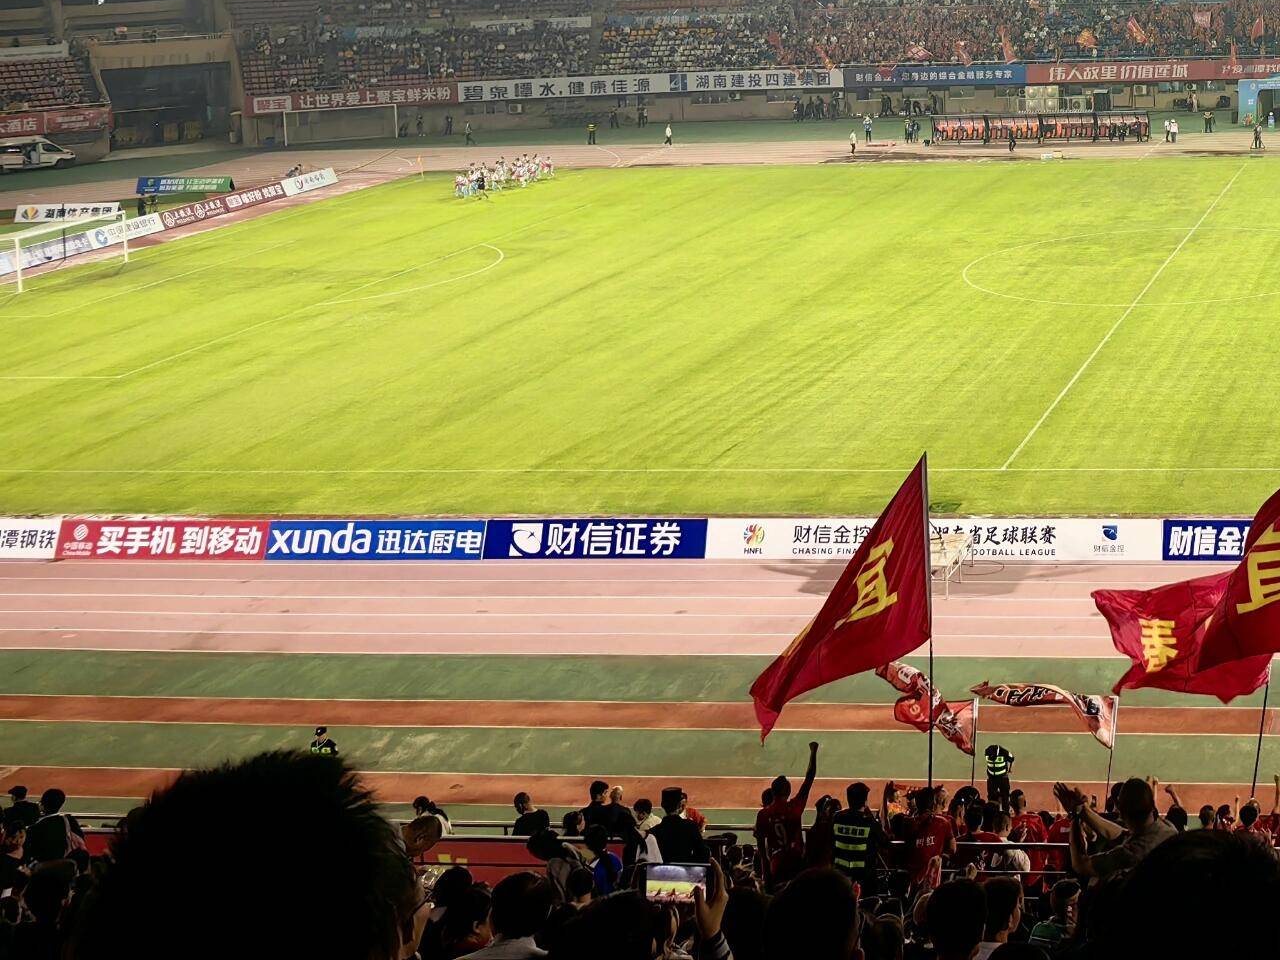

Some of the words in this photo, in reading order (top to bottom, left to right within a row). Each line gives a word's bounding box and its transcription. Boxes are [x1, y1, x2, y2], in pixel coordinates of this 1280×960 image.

[1049, 66, 1117, 81] 伟人故里
[1120, 64, 1188, 79] 价值连城
[299, 86, 450, 109] 让世界爱上聚宝鲜米粉
[0, 529, 56, 549] 潭钢铁
[96, 526, 176, 554] 买手机
[179, 526, 263, 555] 到移动
[268, 523, 371, 553] xunda
[375, 529, 483, 553] 迅达厨电
[545, 522, 682, 556] 财信证券
[1169, 526, 1248, 556] 财信金
[1019, 548, 1056, 556] LEAGUE
